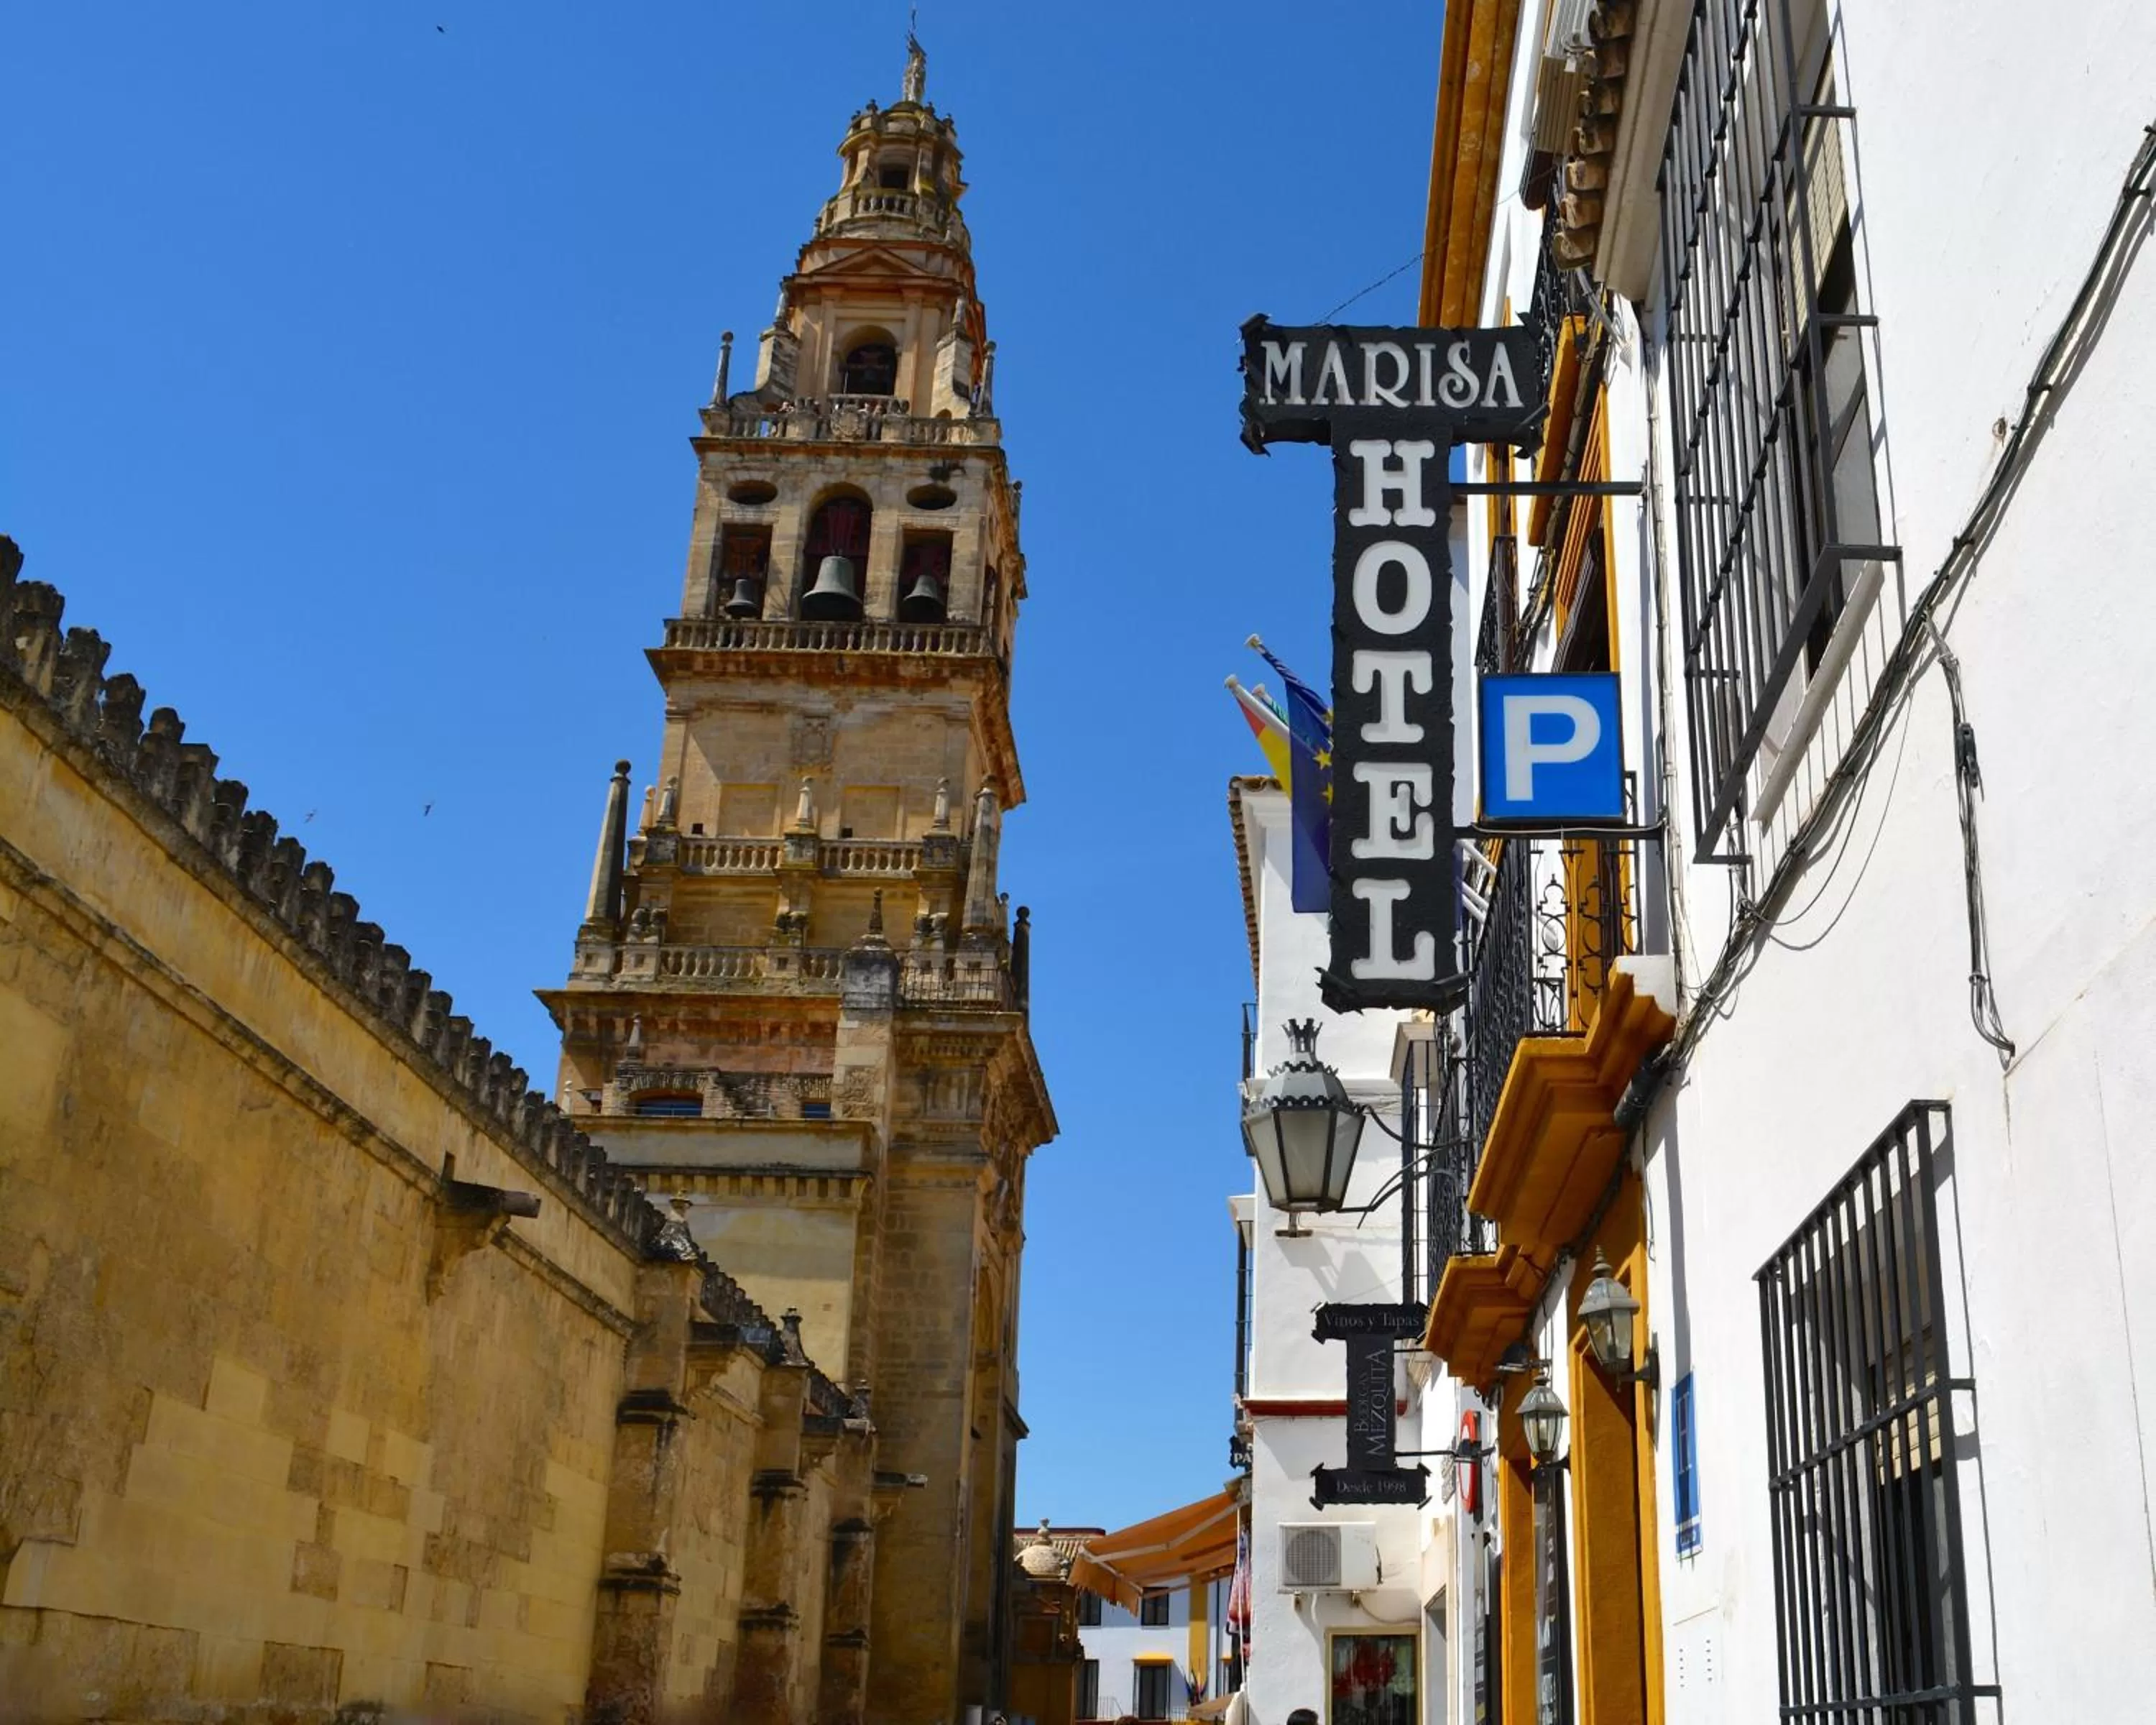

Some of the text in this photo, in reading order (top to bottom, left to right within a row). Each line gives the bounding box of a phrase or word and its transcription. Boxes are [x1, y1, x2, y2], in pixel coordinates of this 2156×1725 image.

[1259, 341, 1525, 409] MARISA
[1348, 439, 1436, 980] HOTEL
[1503, 694, 1601, 801] P
[1325, 1312, 1420, 1332] Vinos y Tapas
[1365, 1348, 1390, 1456] MEZQUITA
[1336, 1480, 1373, 1494] Desde
